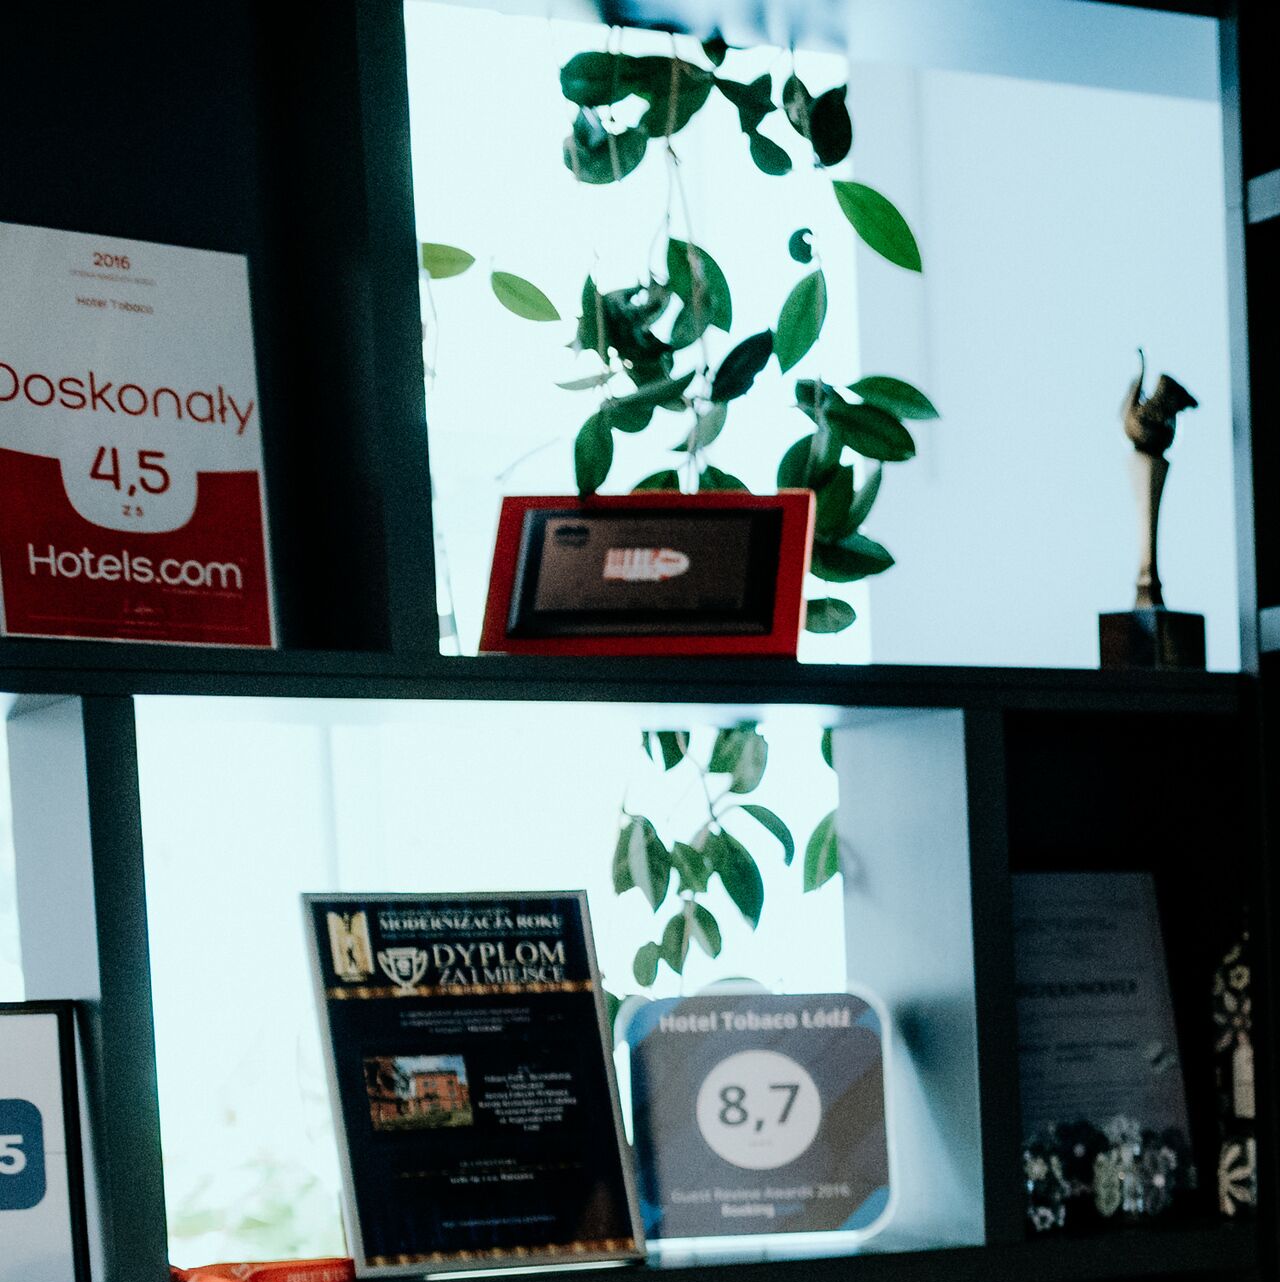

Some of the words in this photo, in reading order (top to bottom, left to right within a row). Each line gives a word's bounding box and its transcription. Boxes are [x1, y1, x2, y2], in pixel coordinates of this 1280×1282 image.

[93, 252, 130, 270] 2016
[90, 446, 170, 496] 4,5
[27, 542, 243, 589] Hotels.com
[432, 940, 567, 968] DYPLOM
[659, 1011, 718, 1033] Hotel
[720, 1009, 799, 1031] Tobaco
[719, 1085, 800, 1132] 8,7
